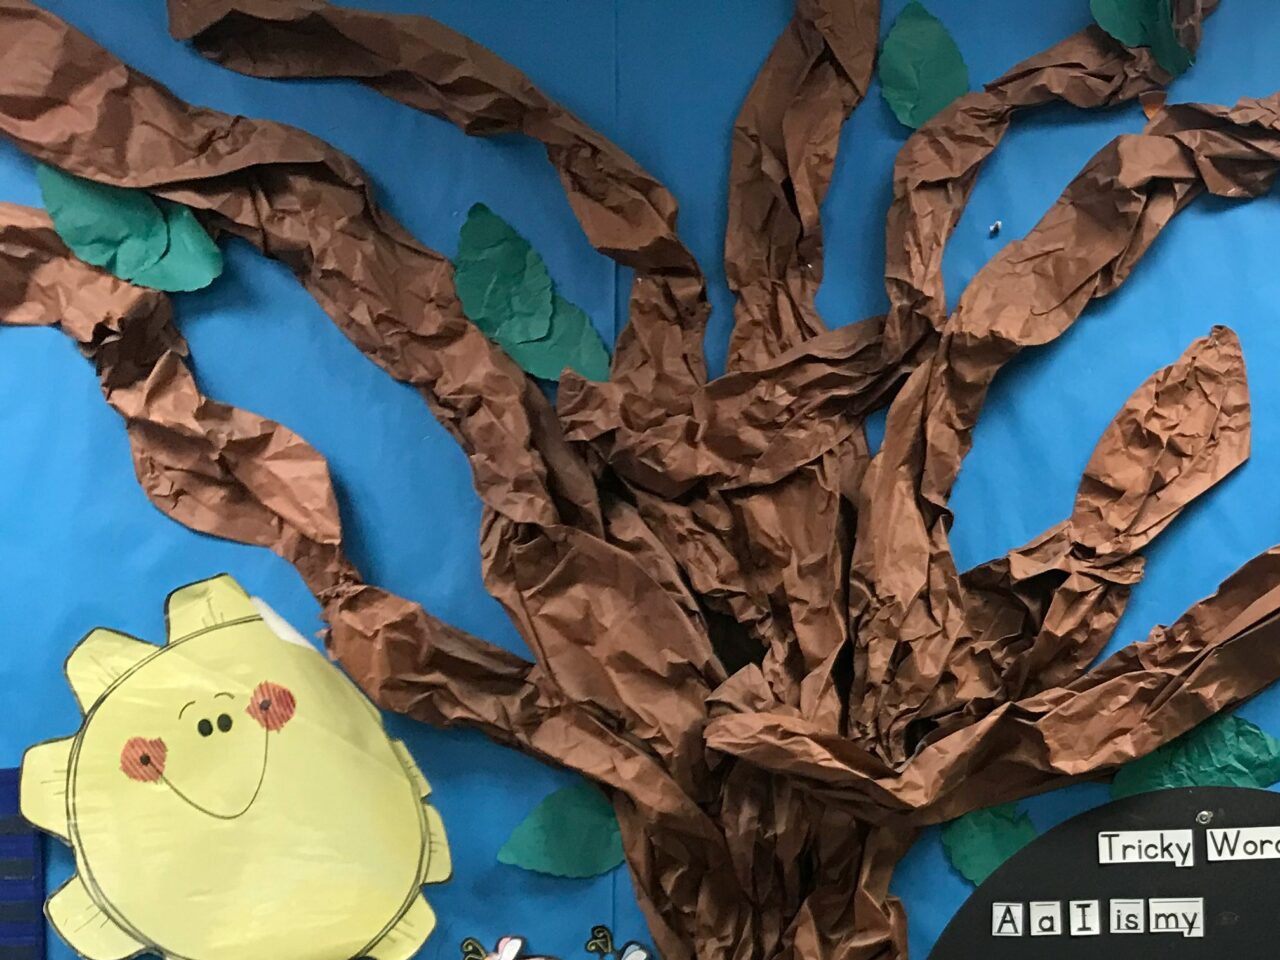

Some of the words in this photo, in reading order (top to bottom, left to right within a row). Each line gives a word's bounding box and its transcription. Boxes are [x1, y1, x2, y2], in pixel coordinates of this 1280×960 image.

[1101, 833, 1191, 865] Tricky
[996, 905, 1019, 933] A
[1038, 914, 1054, 932] a
[1076, 903, 1091, 931] I
[1116, 909, 1139, 930] is
[1154, 911, 1198, 936] my
